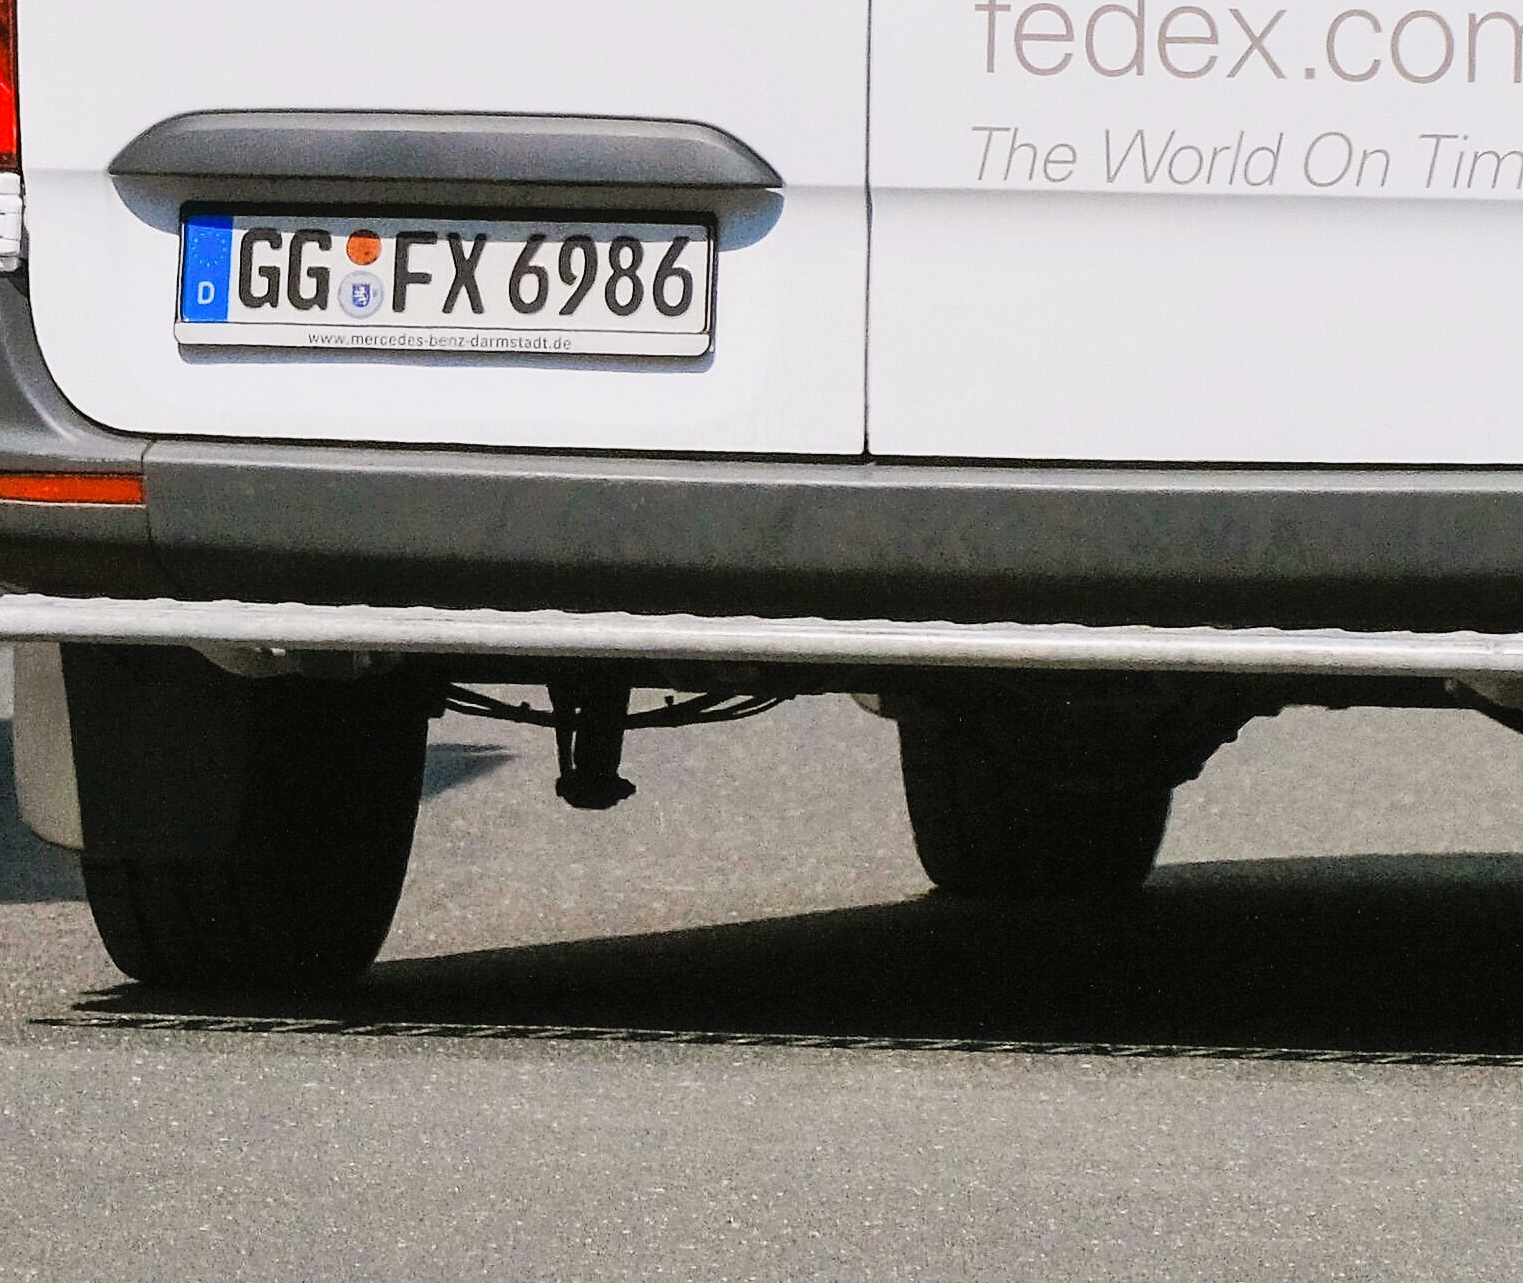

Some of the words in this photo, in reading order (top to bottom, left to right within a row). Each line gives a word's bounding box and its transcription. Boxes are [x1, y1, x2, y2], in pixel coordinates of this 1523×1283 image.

[971, 126, 1077, 183] The
[1104, 128, 1284, 187] World
[1303, 131, 1390, 188] On
[196, 281, 215, 306] D
[238, 229, 333, 312] GG
[392, 230, 487, 315] FX
[508, 233, 695, 318] 6986
[307, 331, 573, 352] www.mercedes-benz-darmstadt.de
